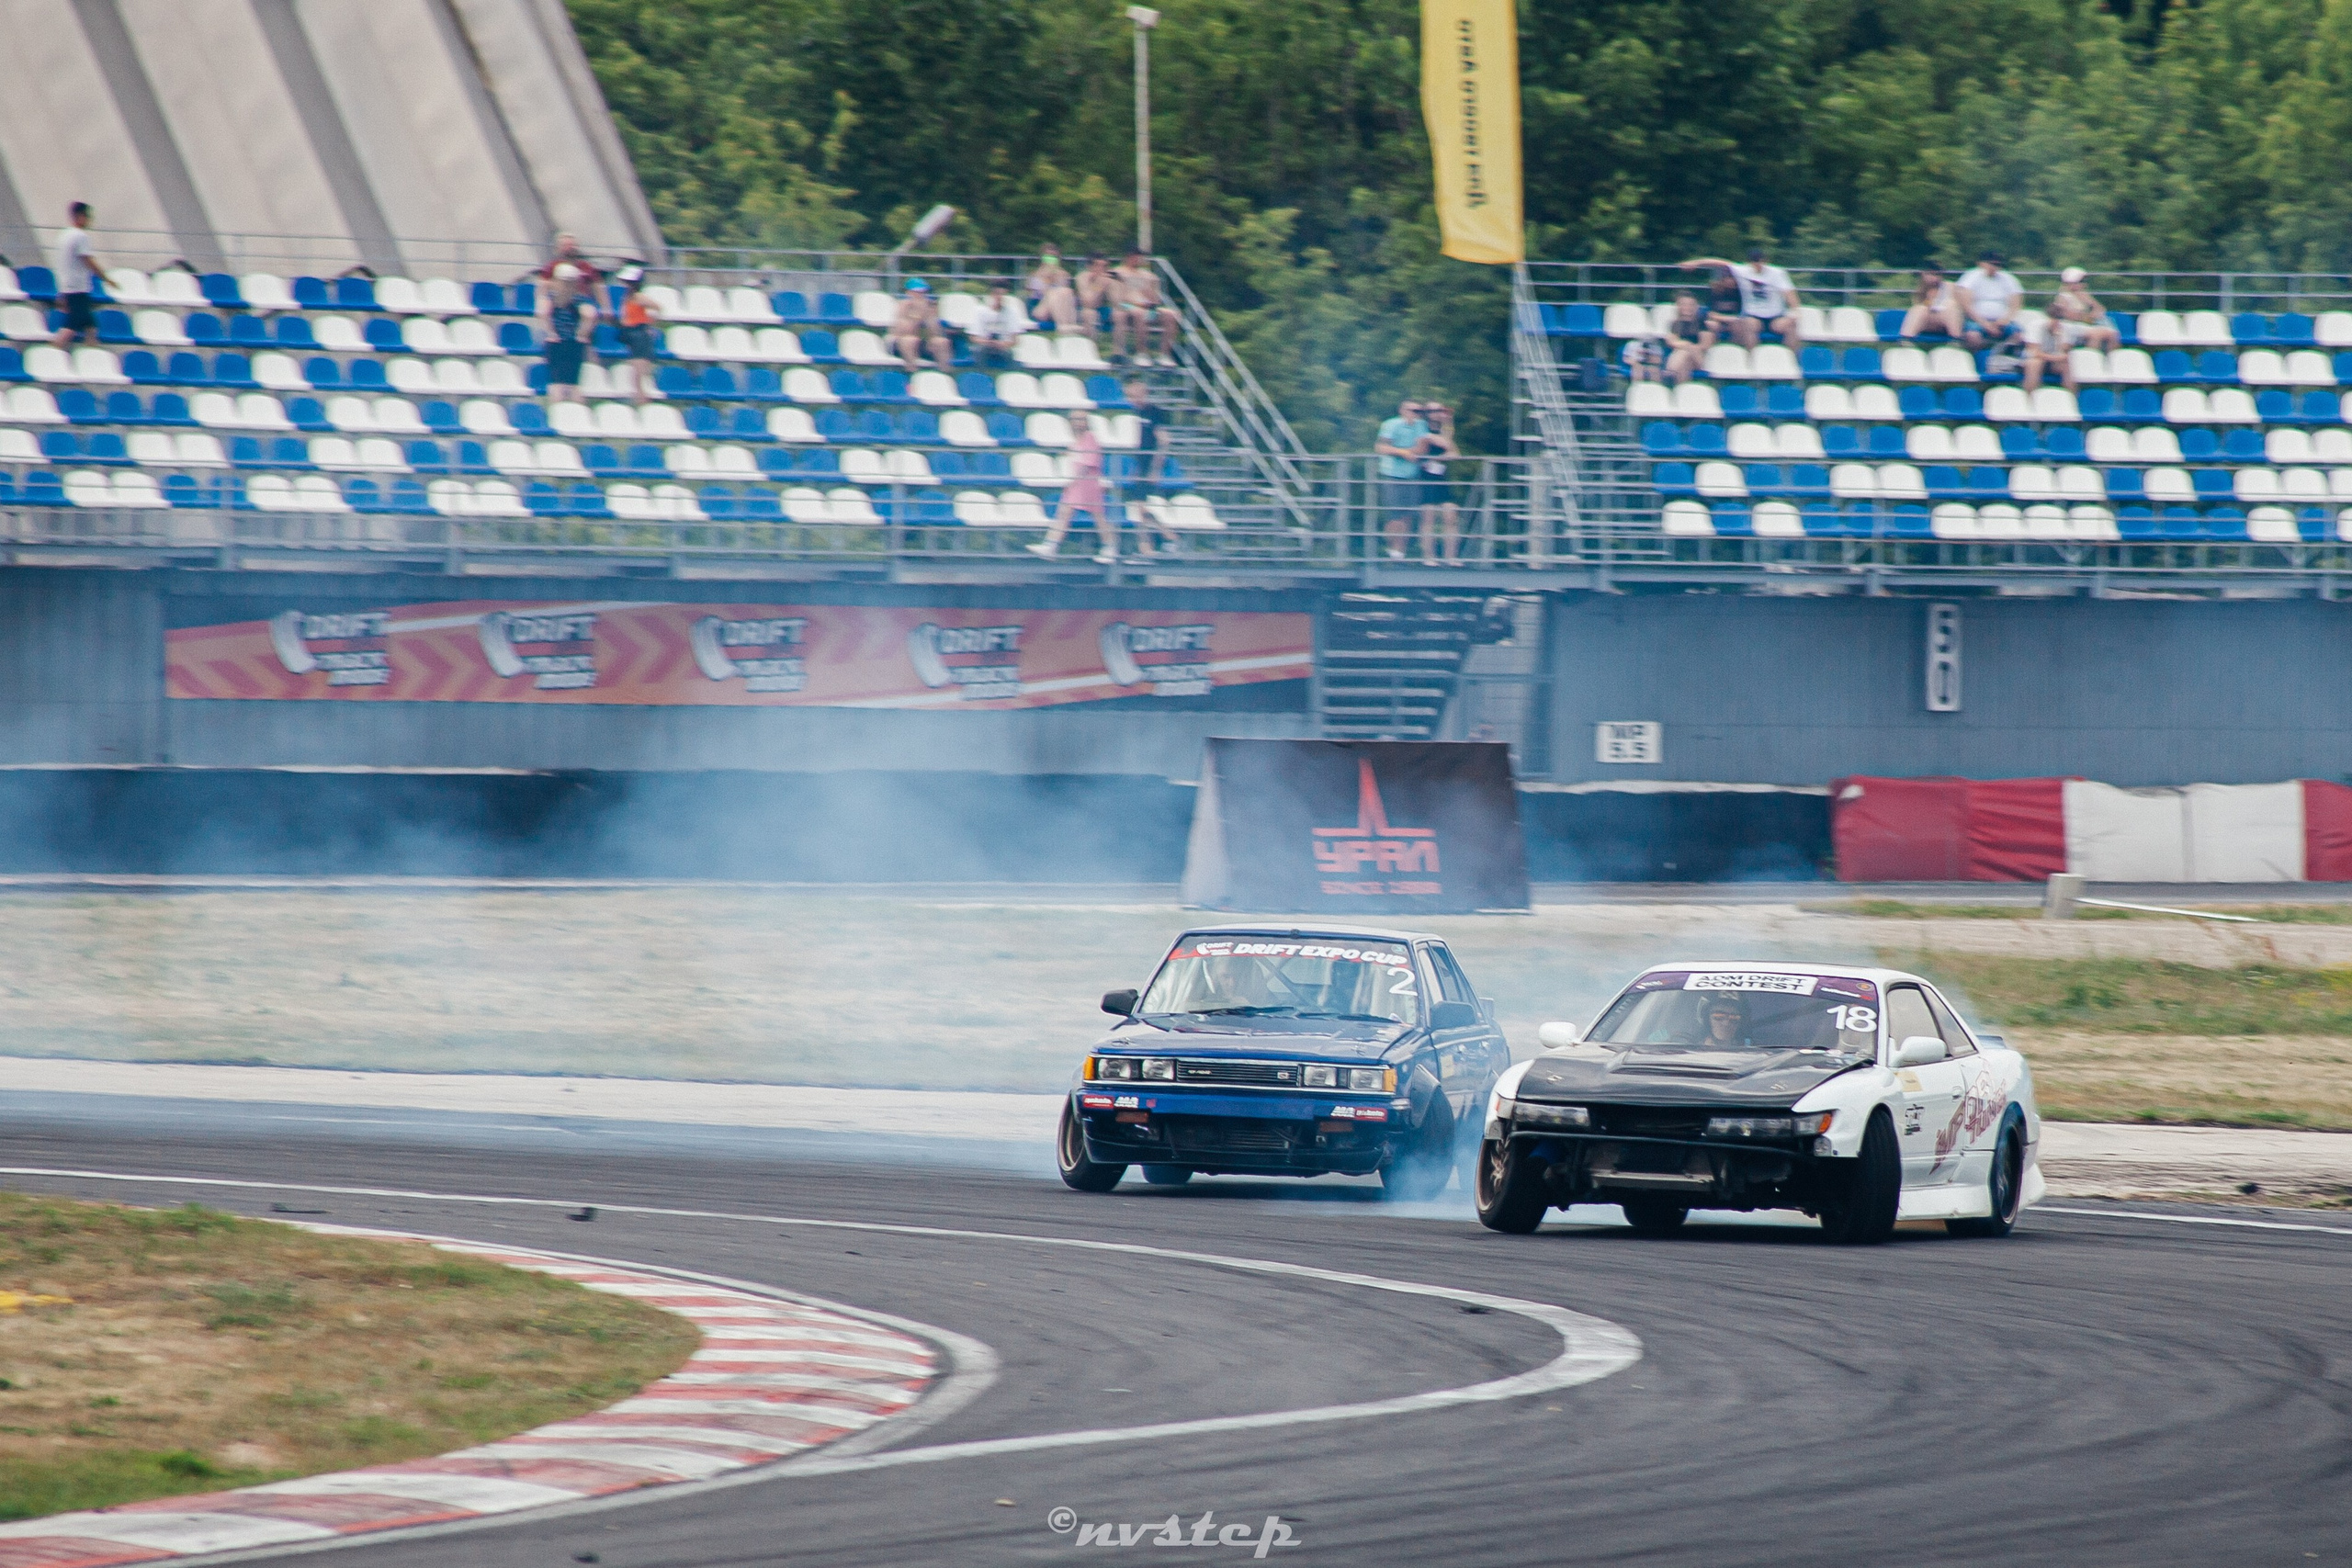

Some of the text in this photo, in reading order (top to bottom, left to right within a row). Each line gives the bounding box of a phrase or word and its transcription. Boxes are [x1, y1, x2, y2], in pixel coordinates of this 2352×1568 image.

[305, 613, 390, 637] DRIFT
[513, 615, 595, 641] DRIFT
[722, 619, 808, 644] DRIFT
[940, 626, 1023, 651] DRIFT
[1132, 626, 1215, 650] DRIFT
[1233, 943, 1303, 955] DRIFT
[1298, 945, 1361, 960] EXPO
[1361, 950, 1408, 965] CUP
[1386, 966, 1419, 997] 2
[1695, 980, 1804, 990] CONTEST
[1748, 975, 1806, 984] DRIFT
[1826, 1004, 1877, 1032] 18
